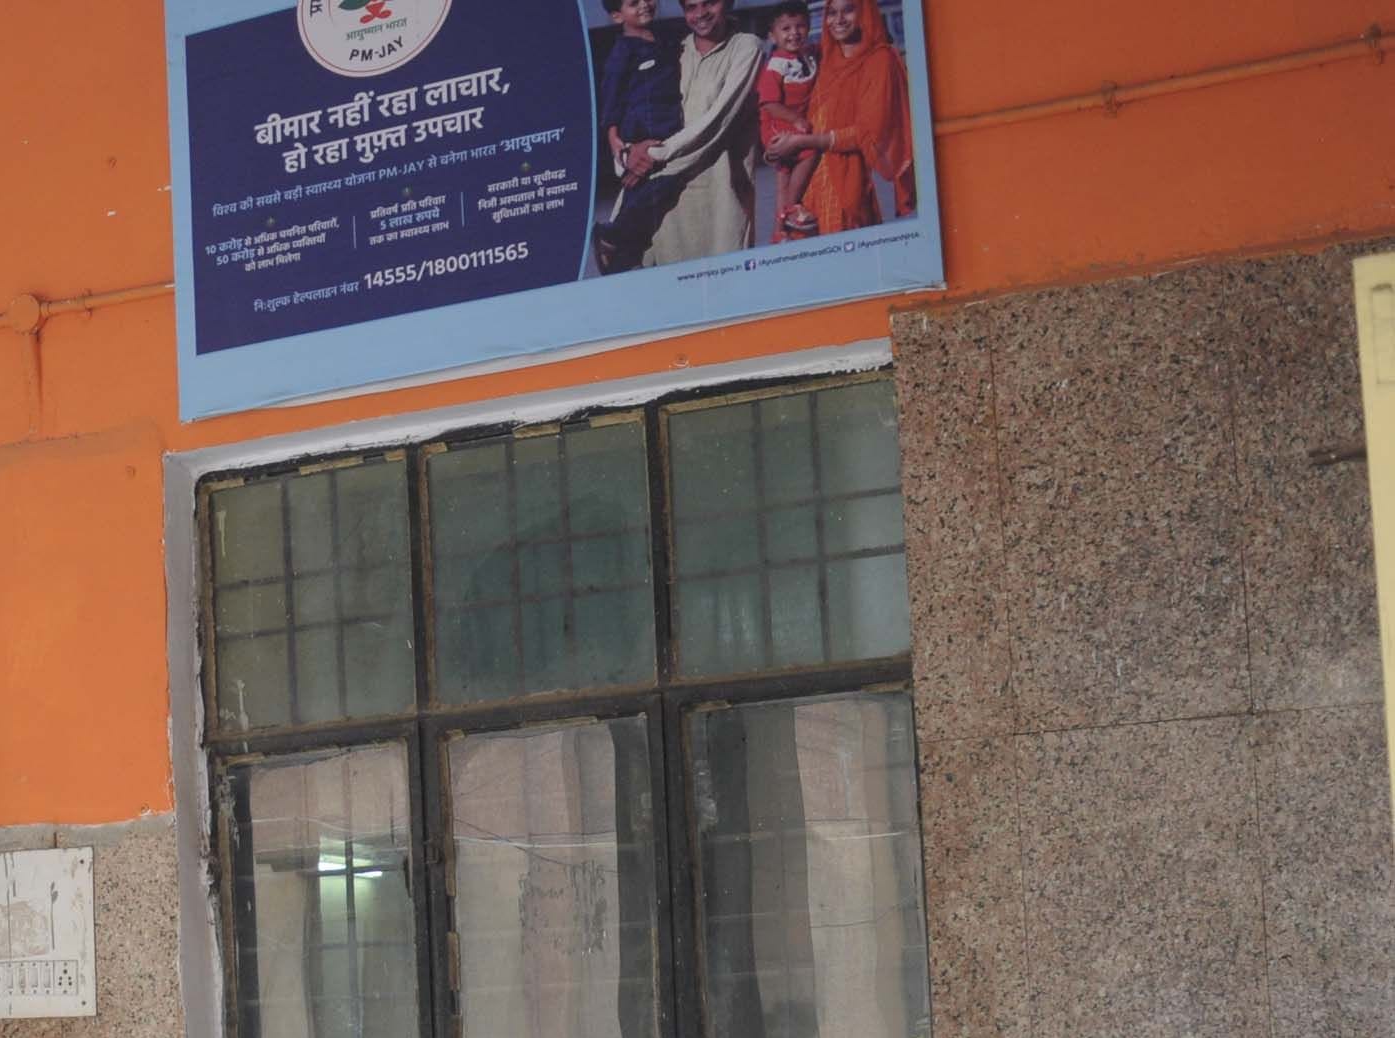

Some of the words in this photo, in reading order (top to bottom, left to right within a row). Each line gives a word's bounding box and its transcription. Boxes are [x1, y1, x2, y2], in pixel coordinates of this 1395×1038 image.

[349, 35, 404, 62] PM-JAY
[254, 111, 321, 146] बीमार
[328, 91, 375, 130] नहीं
[377, 88, 418, 118] रहा
[424, 67, 510, 105] लाचार,
[283, 143, 306, 173] हो
[312, 138, 348, 167] रहा
[413, 107, 484, 143] उपचार
[240, 198, 254, 211] की
[345, 171, 376, 188] योजना
[379, 161, 425, 179] PM-JAY
[428, 156, 437, 169] से
[470, 143, 496, 157] भारत
[380, 220, 386, 230] 5
[216, 256, 229, 266] 50
[364, 242, 529, 289] 14555/1800111565
